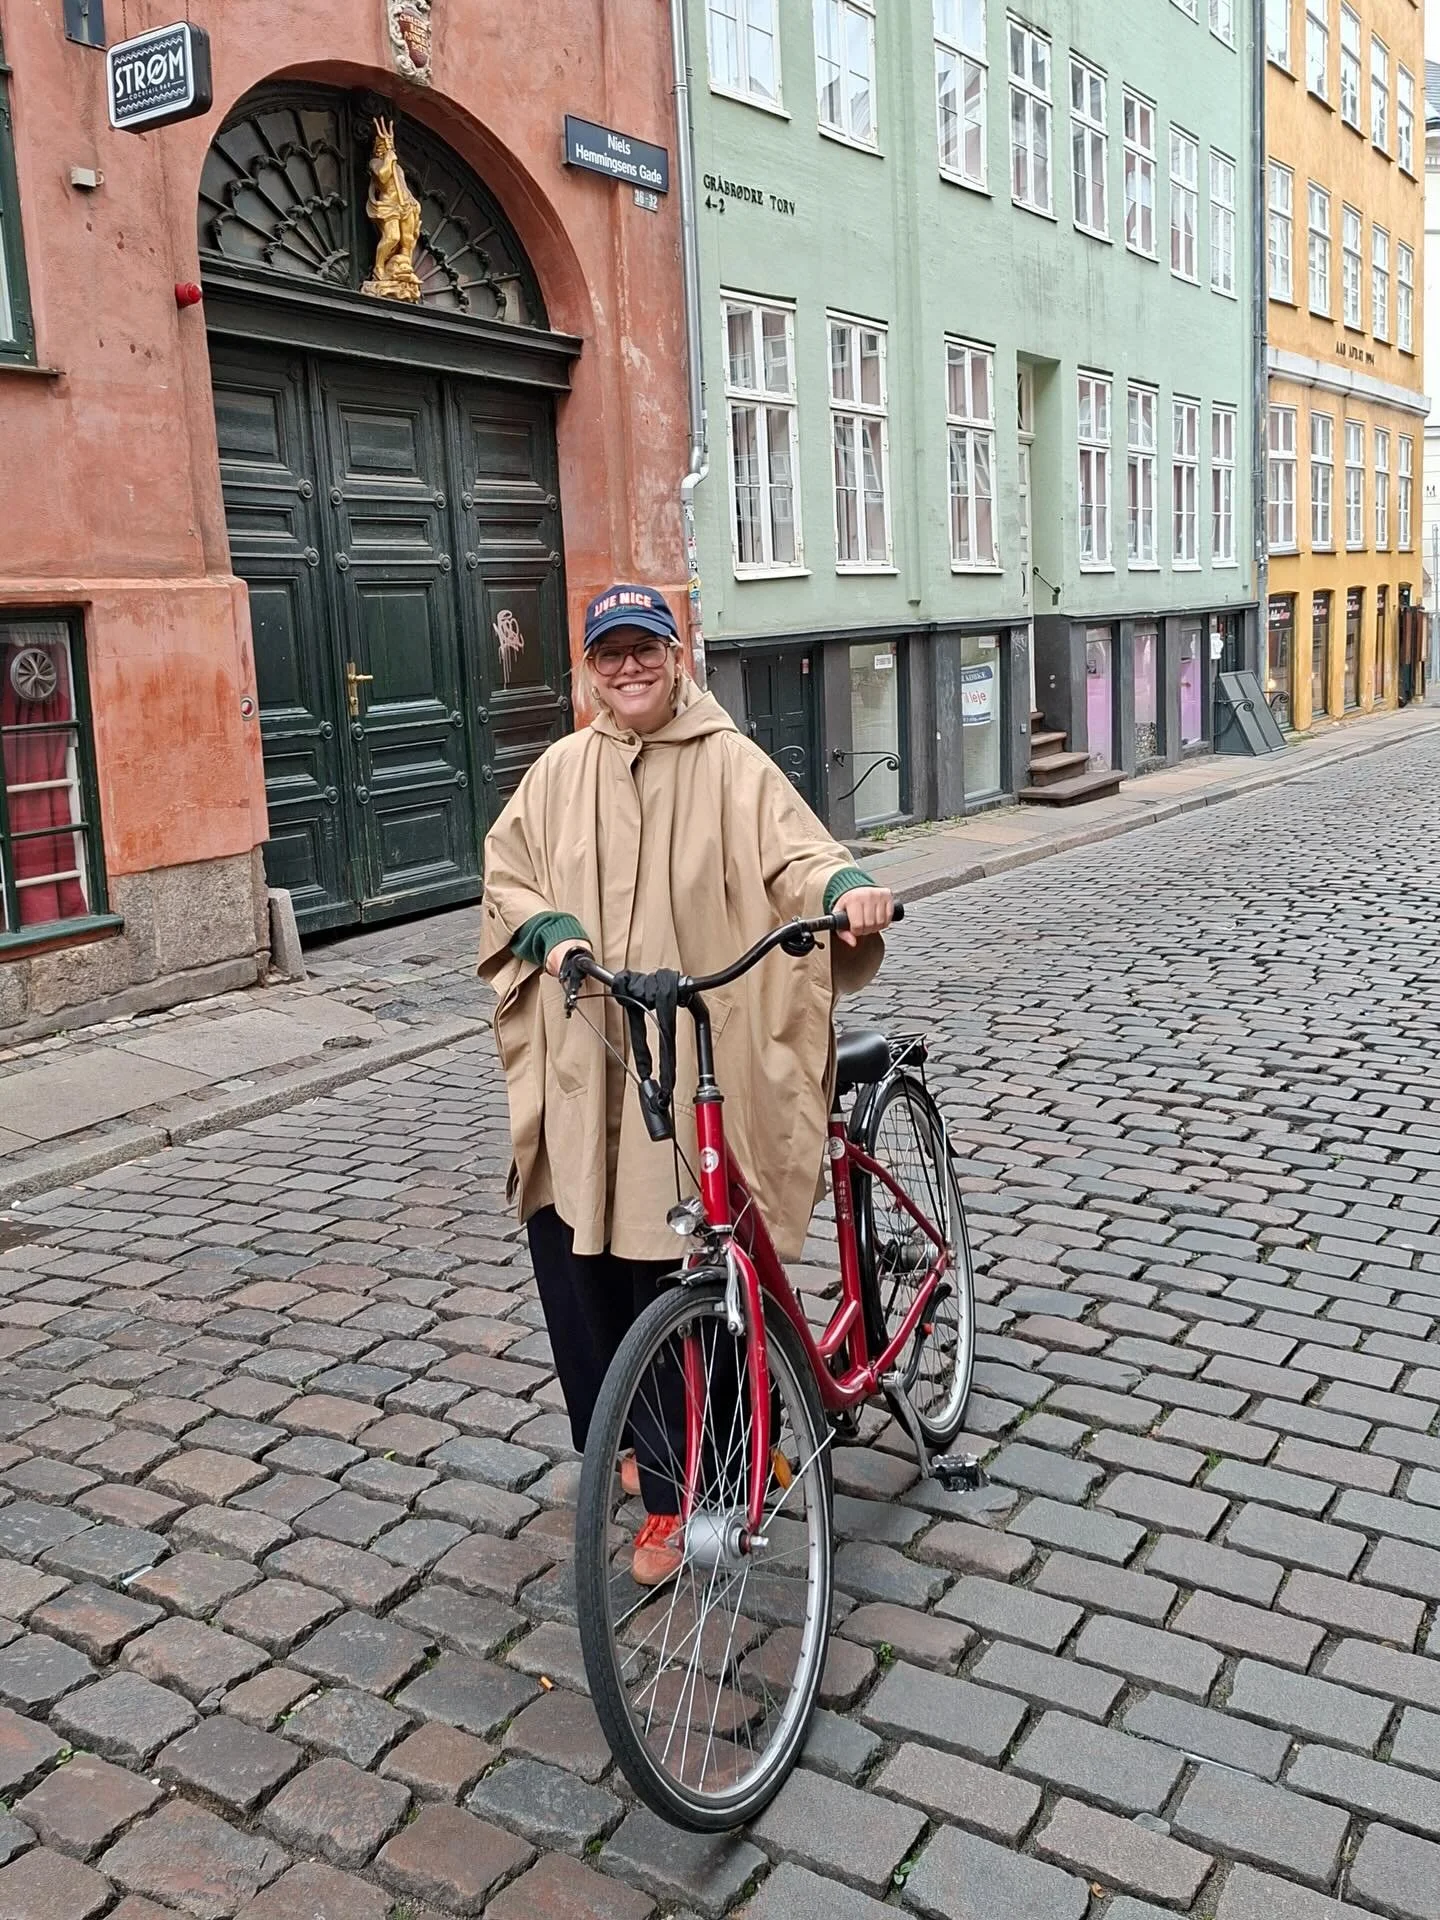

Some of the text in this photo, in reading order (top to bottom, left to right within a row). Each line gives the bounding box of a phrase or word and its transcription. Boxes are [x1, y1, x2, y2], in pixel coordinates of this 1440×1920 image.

[115, 46, 184, 98] STRØM
[607, 133, 631, 156] Niels
[575, 142, 663, 185] Hemmingsens Gade
[703, 173, 796, 216] GRÅBRØDRE TORV
[705, 194, 726, 214] 4-2
[594, 594, 617, 618] LIVE
[619, 591, 652, 609] NICE
